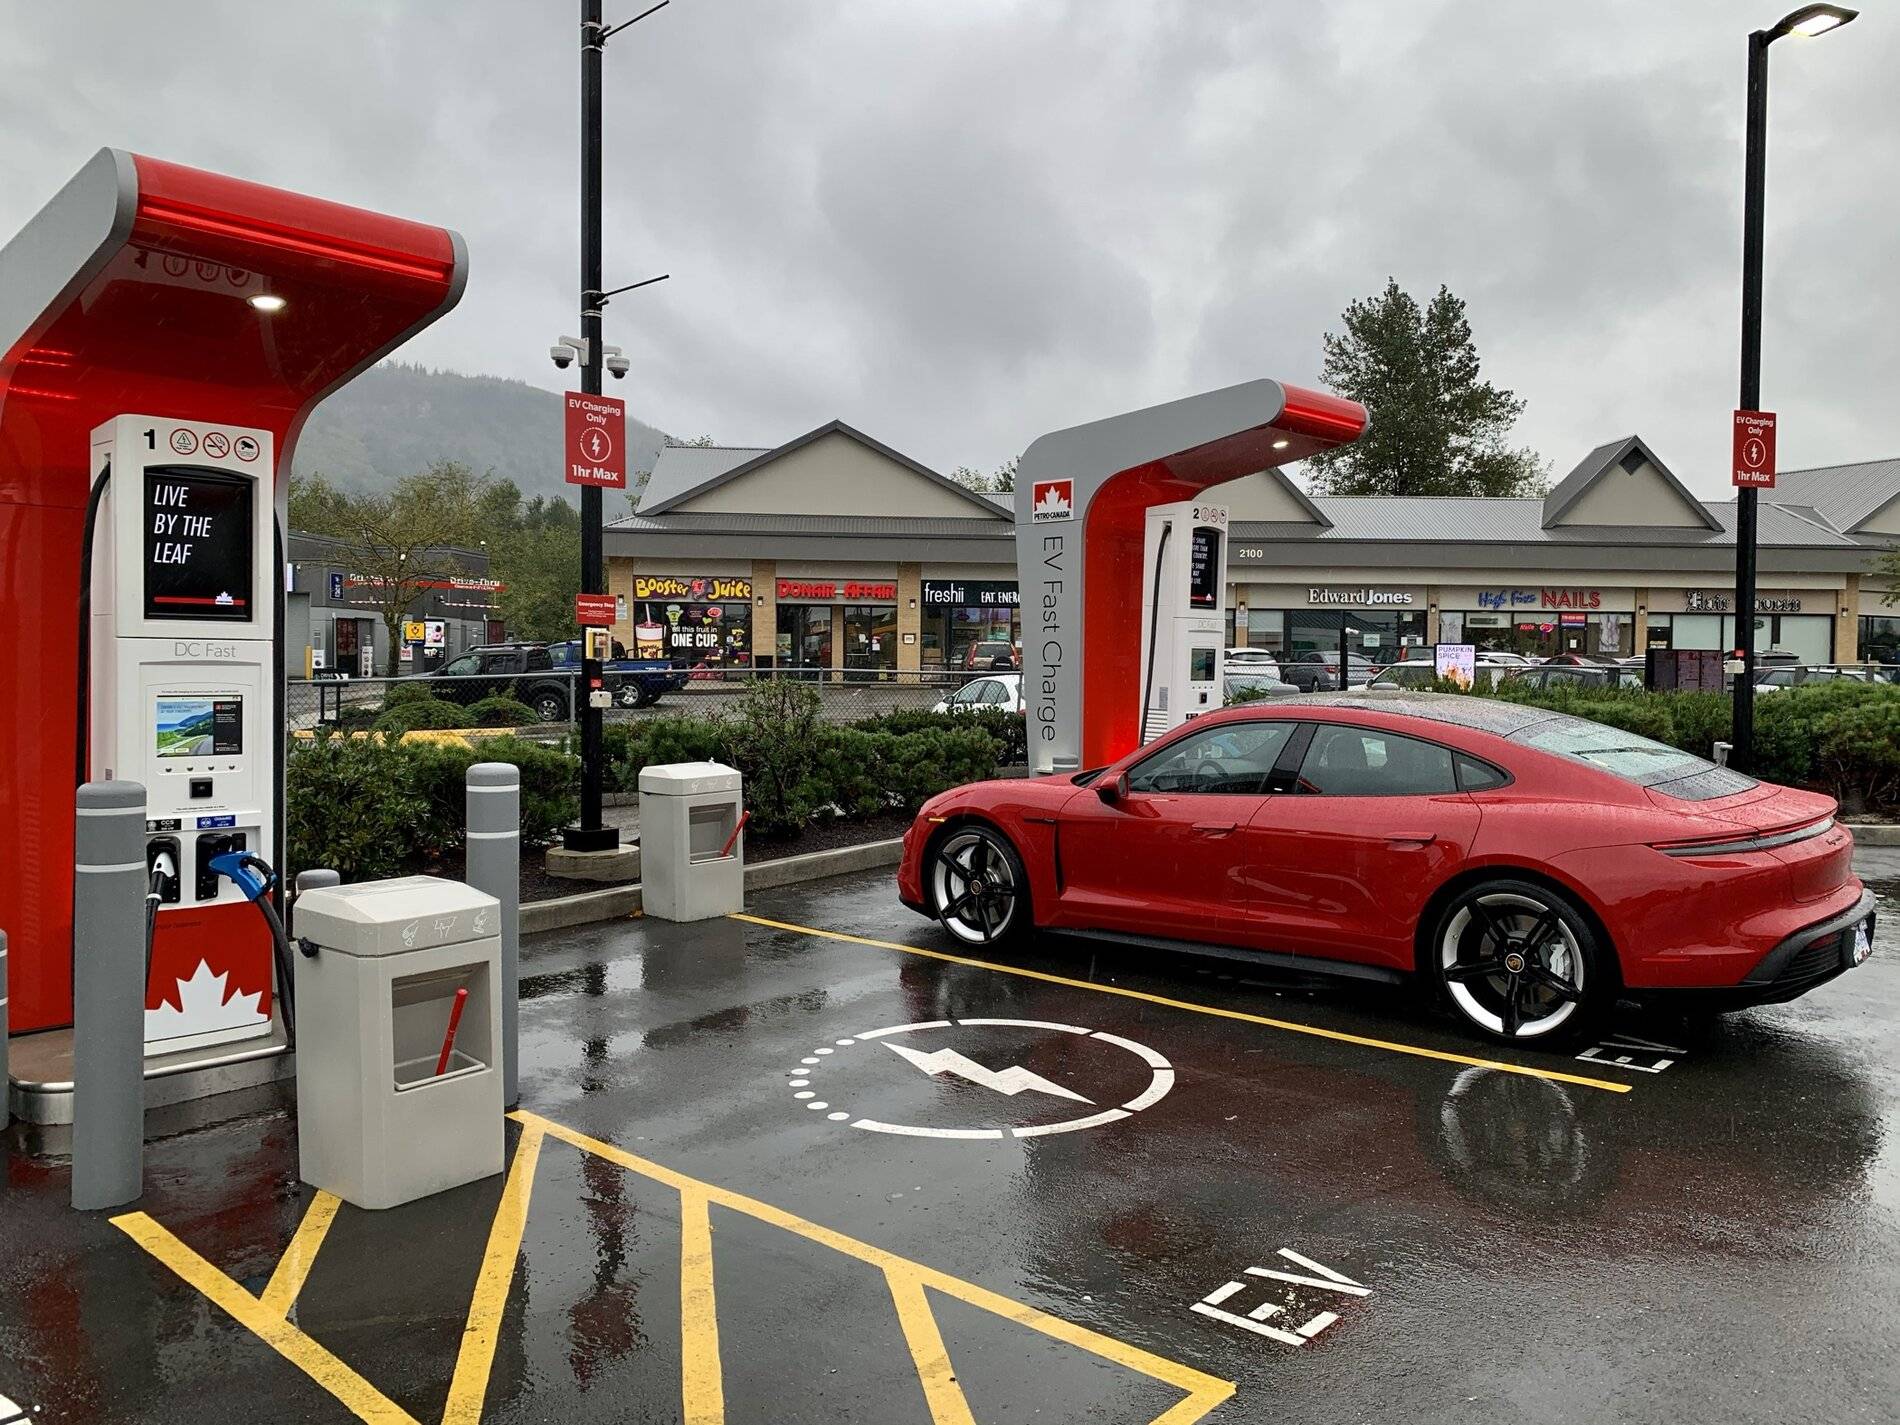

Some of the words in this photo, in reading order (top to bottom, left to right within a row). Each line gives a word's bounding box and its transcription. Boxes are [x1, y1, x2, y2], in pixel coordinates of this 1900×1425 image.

[569, 399, 581, 408] EV
[582, 401, 621, 416] Charging
[586, 413, 606, 425] Only
[1746, 417, 1774, 427] Charging
[143, 428, 156, 450] 1
[1748, 426, 1763, 436] Only
[572, 464, 591, 478] 1hr
[593, 468, 619, 481] Max
[1737, 470, 1751, 481] 1hr
[1752, 472, 1770, 482] Max
[153, 484, 189, 508] LIVE
[1034, 510, 1070, 520] PETRO-CANADA
[1193, 508, 1200, 519] 2
[153, 514, 176, 535] BY
[183, 515, 213, 538] THE
[153, 543, 193, 566] LEAF
[1043, 536, 1064, 571] EV
[1240, 549, 1263, 558] 2100
[635, 578, 689, 598] Booster
[708, 580, 751, 600] Juice
[924, 583, 964, 602] freshii
[981, 592, 996, 604] EAT.
[1541, 588, 1600, 609] NAILS
[1042, 580, 1063, 633] Fast
[174, 642, 201, 658] DC
[205, 643, 237, 658] Fast
[672, 634, 693, 647] ONE
[696, 634, 718, 647] CUP.
[1037, 641, 1062, 741] Charge
[1575, 1033, 1688, 1074] EV
[1189, 1247, 1373, 1346] EV
